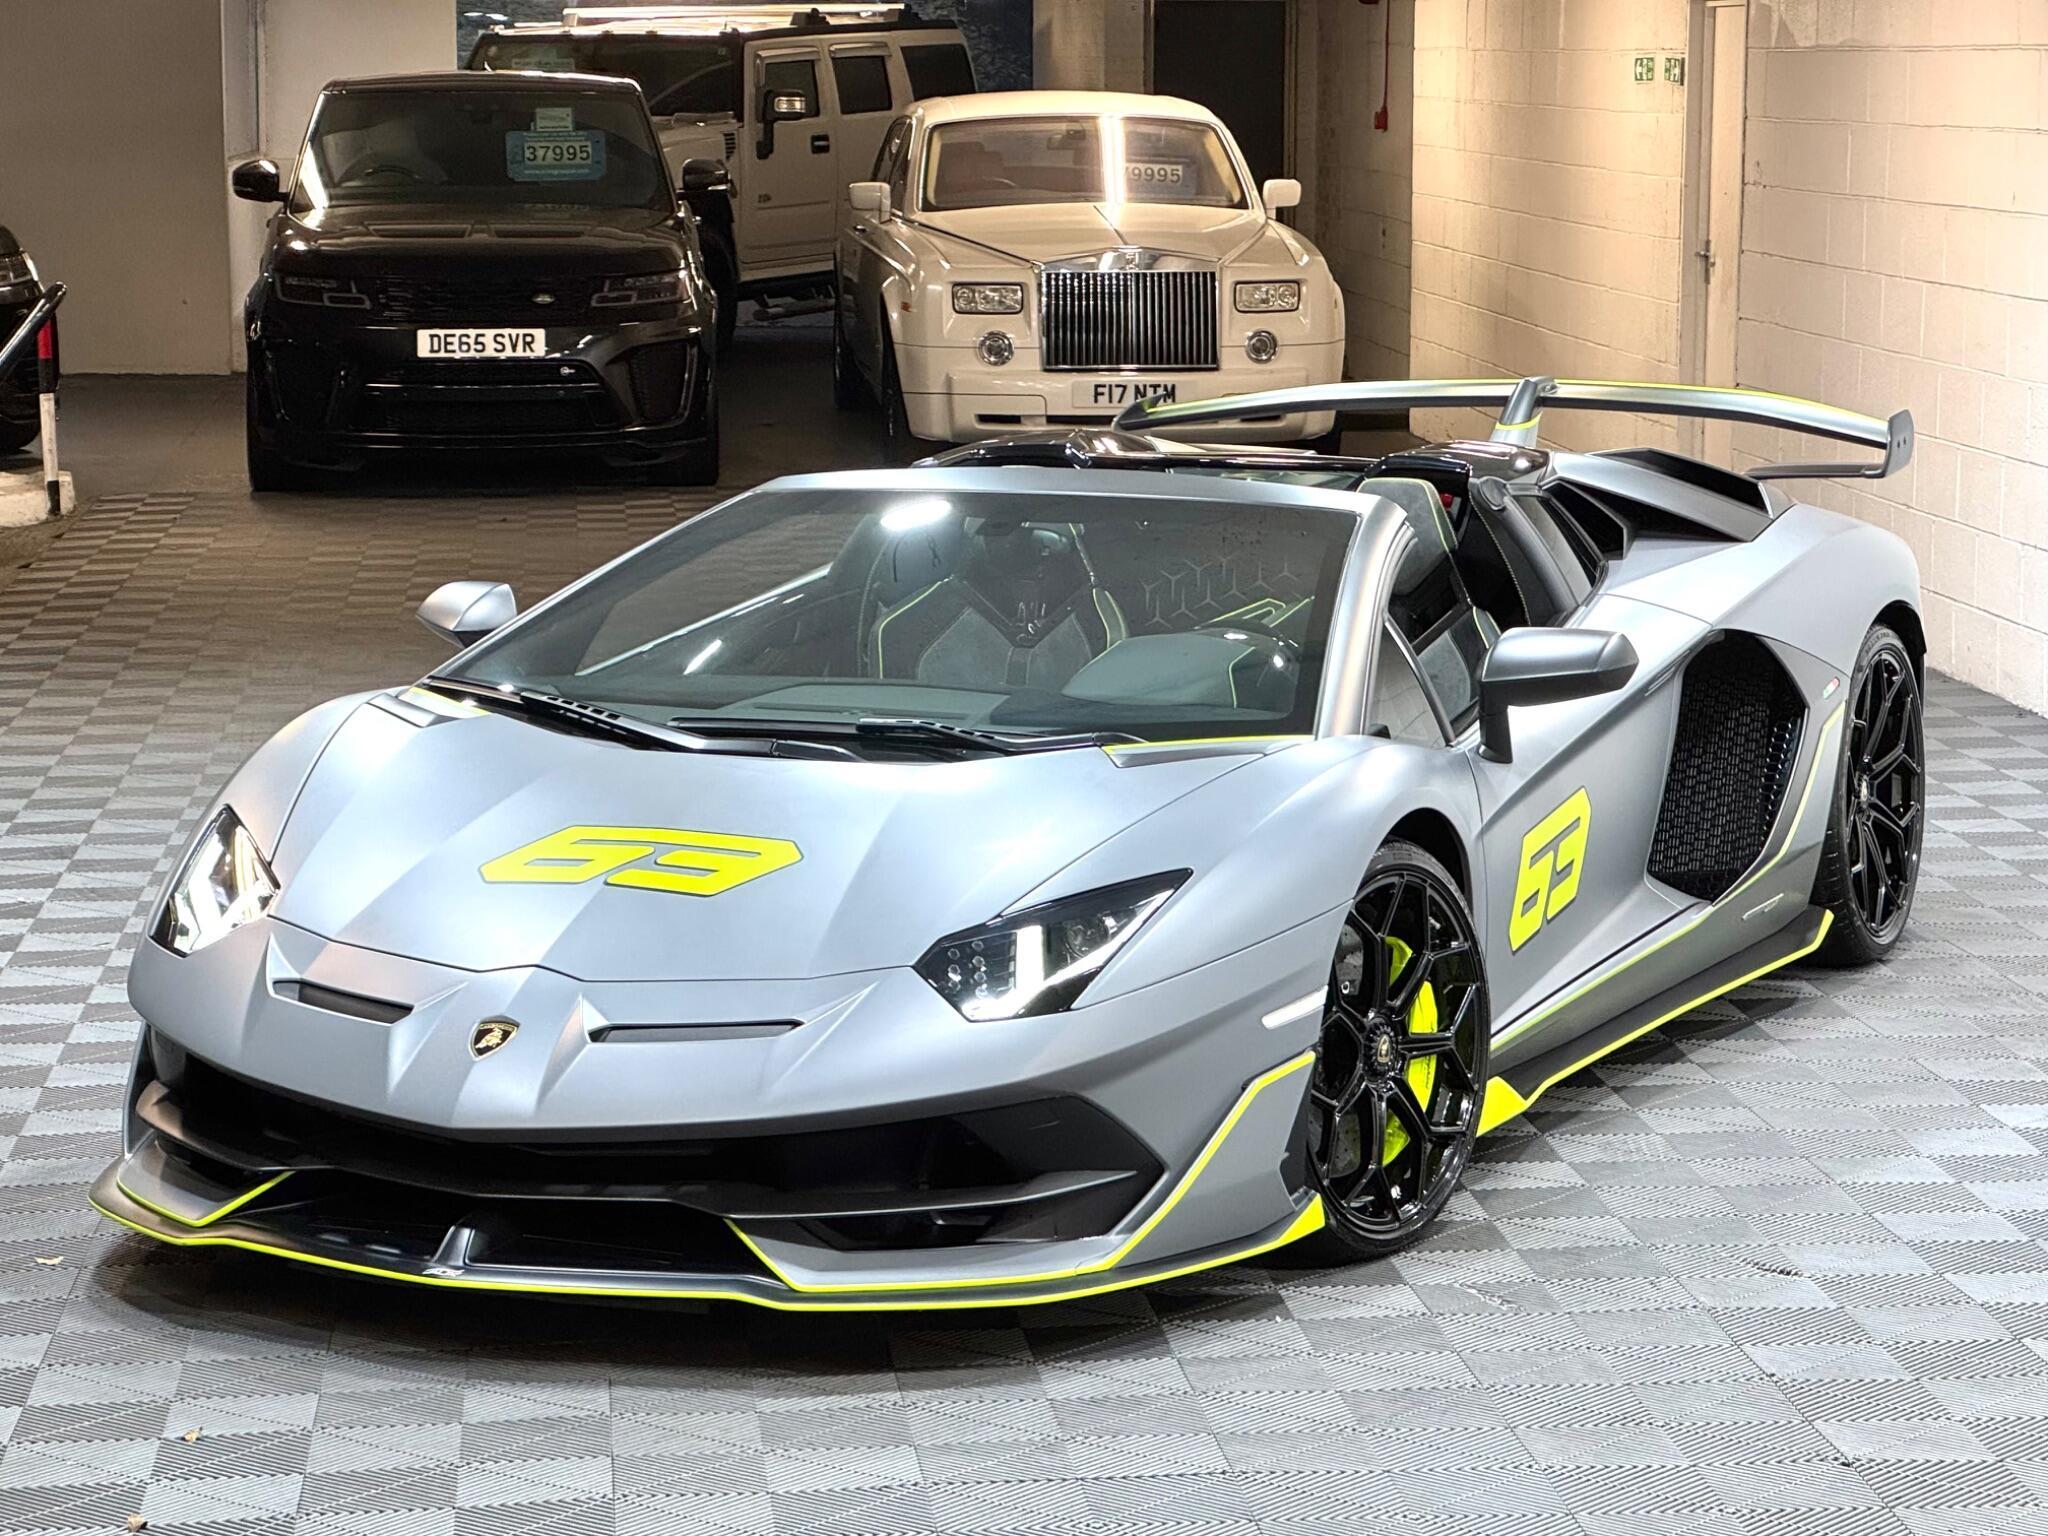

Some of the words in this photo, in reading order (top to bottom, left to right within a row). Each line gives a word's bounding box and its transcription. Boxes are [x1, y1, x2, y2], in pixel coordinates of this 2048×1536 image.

[526, 145, 591, 162] 37995
[428, 333, 486, 354] DE65
[493, 333, 535, 353] SVR
[478, 825, 804, 897] 63
[1508, 785, 1593, 956] 63
